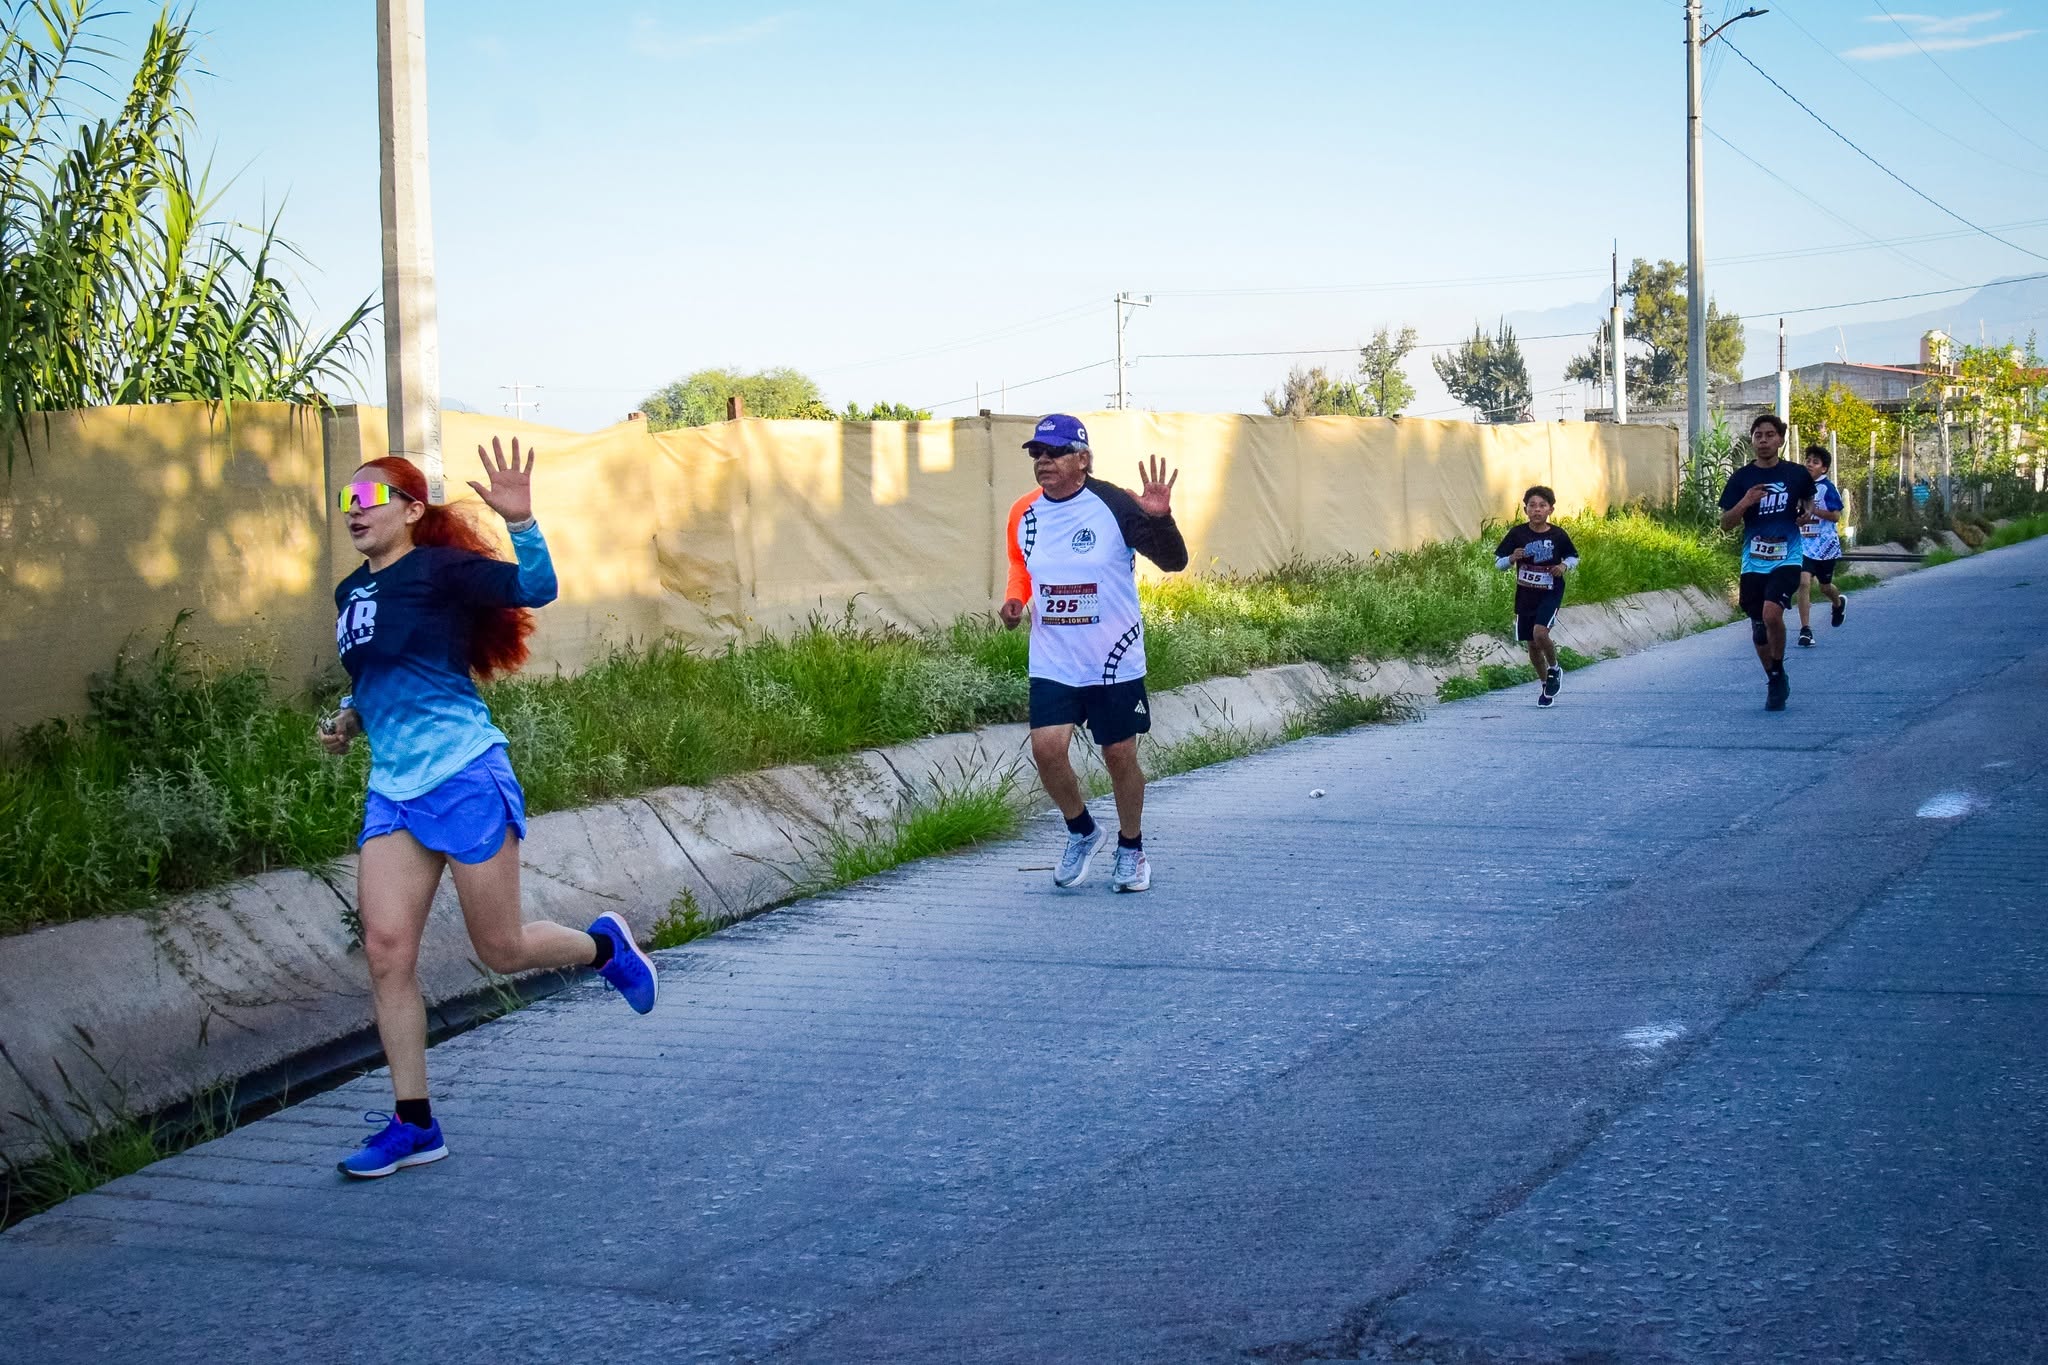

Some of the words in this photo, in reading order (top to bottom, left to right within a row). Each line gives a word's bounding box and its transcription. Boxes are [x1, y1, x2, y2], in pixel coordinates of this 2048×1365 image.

[1755, 544, 1775, 554] 138
[1523, 572, 1542, 582] 155
[1046, 599, 1079, 613] 295
